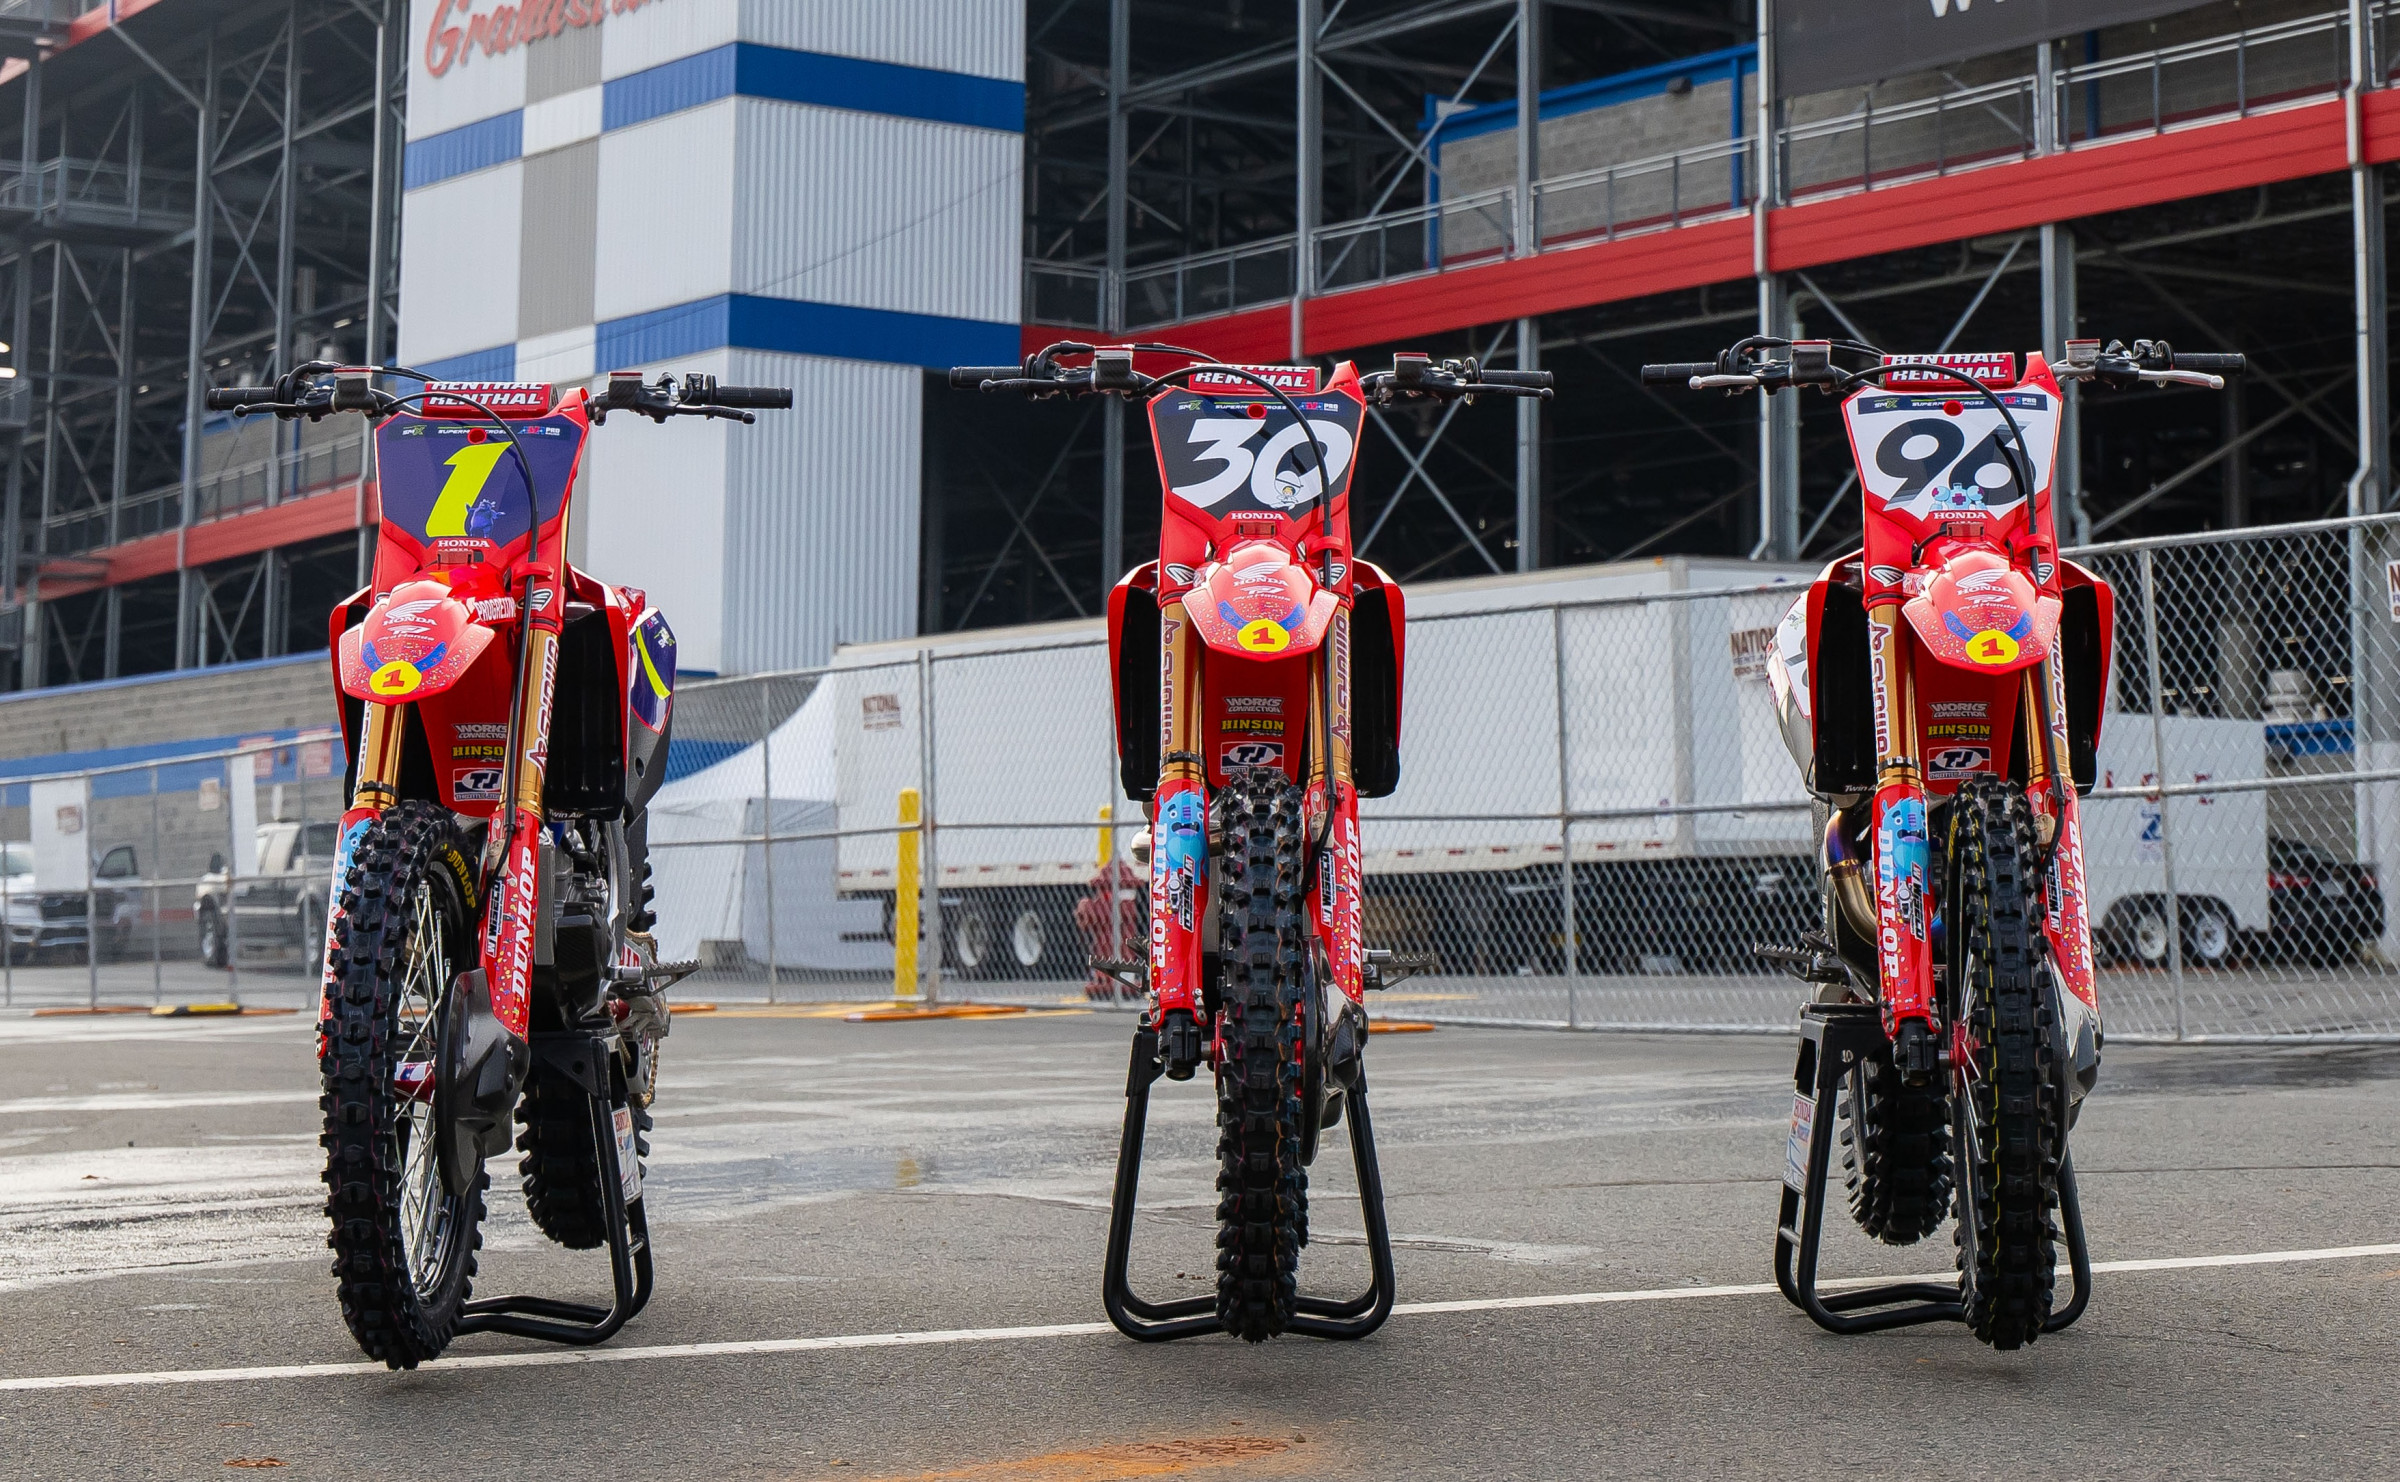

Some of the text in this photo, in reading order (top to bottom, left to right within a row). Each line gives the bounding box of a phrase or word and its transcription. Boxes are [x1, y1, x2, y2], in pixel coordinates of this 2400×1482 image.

[1891, 354, 2004, 365] RENTHAL
[1172, 419, 1353, 508] 30
[1875, 418, 2036, 511] 96
[425, 441, 514, 538] 1
[1231, 512, 1284, 521] HONDA
[1934, 511, 1988, 520] HONDA
[437, 540, 490, 548] HONDA
[1233, 577, 1289, 587] HONDA
[1957, 585, 2014, 595] HONDA
[383, 616, 437, 626] HONDA
[1252, 627, 1275, 645] 1
[1981, 638, 2004, 657] 1
[382, 669, 405, 687] 1
[1226, 698, 1282, 707] WORKS
[1931, 703, 1988, 711] WORKS
[1222, 719, 1284, 731] HINSON
[1928, 724, 1990, 736] HINSON
[453, 745, 504, 757] HINSO
[449, 849, 476, 908] DUNLOP
[1152, 822, 1168, 968] DUNLOP
[1345, 818, 1362, 972] DUNLOP
[1878, 827, 1900, 978] DUNLOP
[2069, 820, 2093, 970] DUNLOP
[512, 846, 535, 1002] DUNLOP
